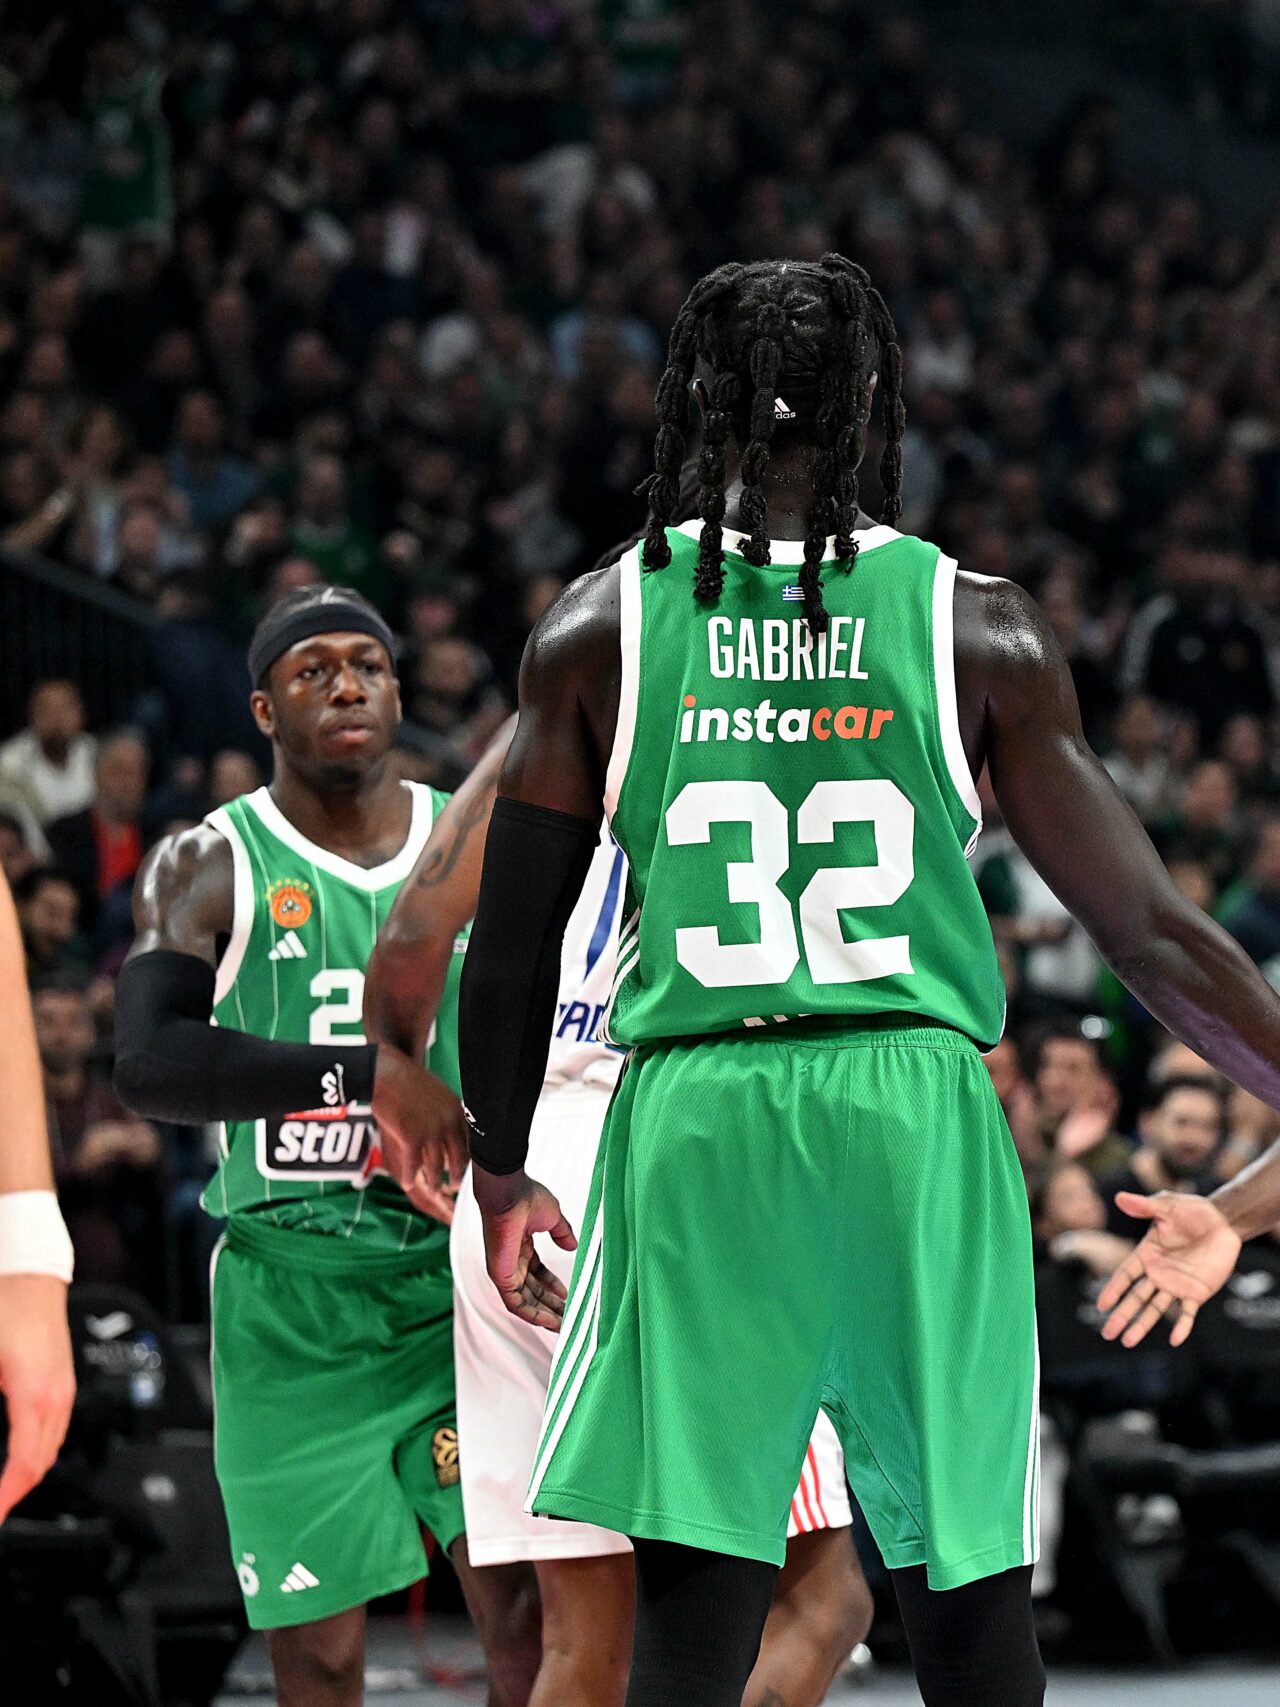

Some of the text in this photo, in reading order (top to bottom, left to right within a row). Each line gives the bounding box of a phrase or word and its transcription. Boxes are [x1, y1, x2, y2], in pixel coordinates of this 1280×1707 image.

[707, 616, 869, 681] GABRIEL
[679, 694, 895, 743] instacar
[665, 780, 915, 988] 32
[309, 968, 369, 1046] 2
